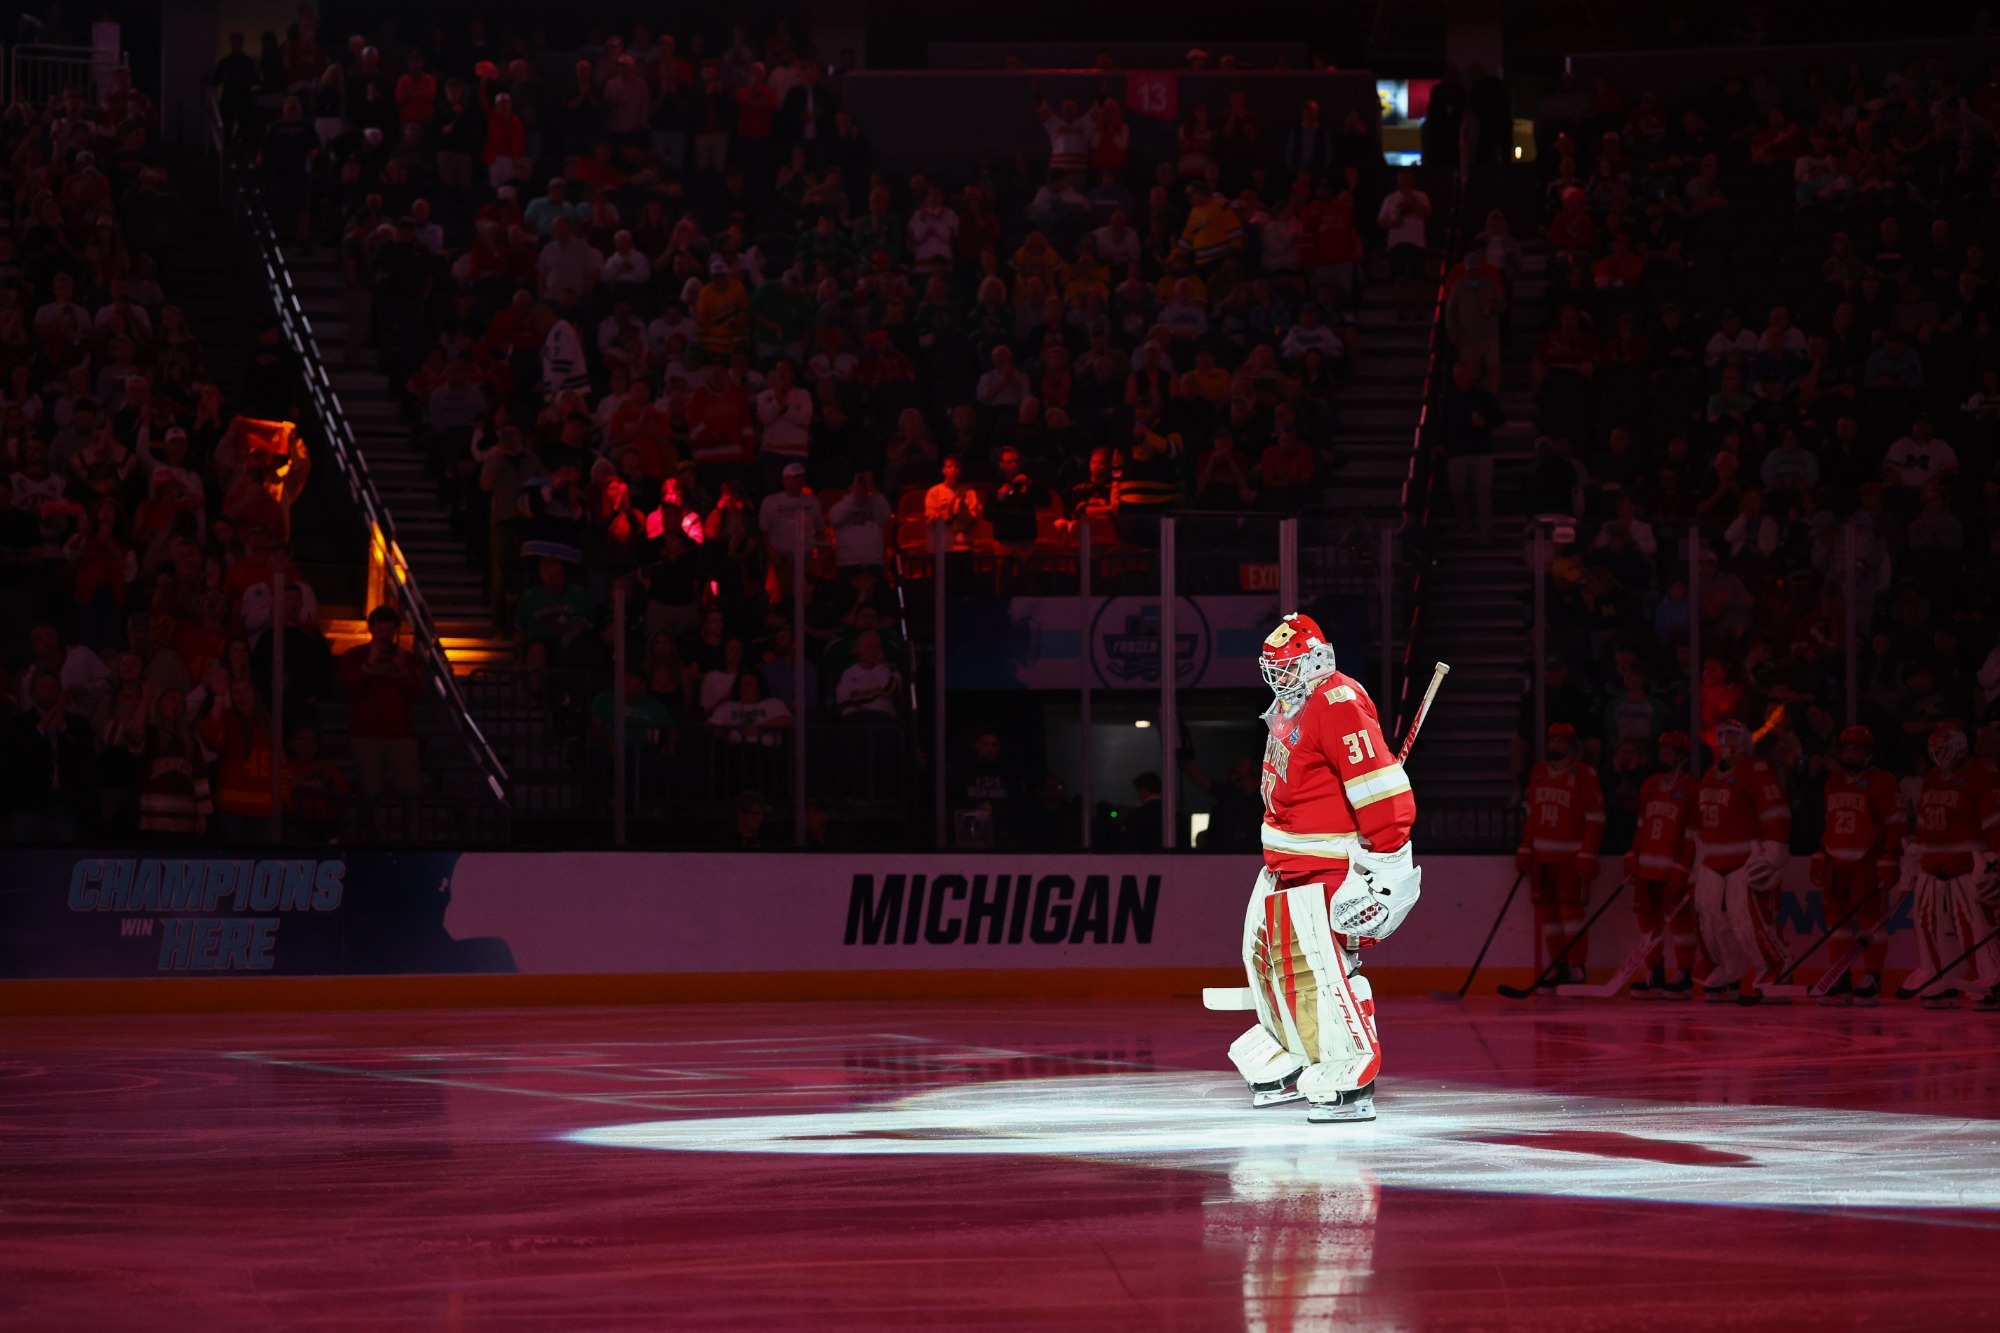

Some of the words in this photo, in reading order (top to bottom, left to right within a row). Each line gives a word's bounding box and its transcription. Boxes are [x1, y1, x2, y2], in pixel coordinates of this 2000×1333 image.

[1136, 83, 1168, 111] 13
[1342, 730, 1376, 764] 31
[1763, 784, 1782, 801] 29
[1541, 804, 1559, 827] 14
[1834, 810, 1856, 834] 23
[1924, 806, 1947, 831] 30
[68, 859, 345, 911] CHAMPIONS
[844, 875, 1161, 945] MICHIGAN
[120, 918, 154, 936] WIN
[158, 917, 280, 970] HERE
[1334, 986, 1365, 1050] TRUE
